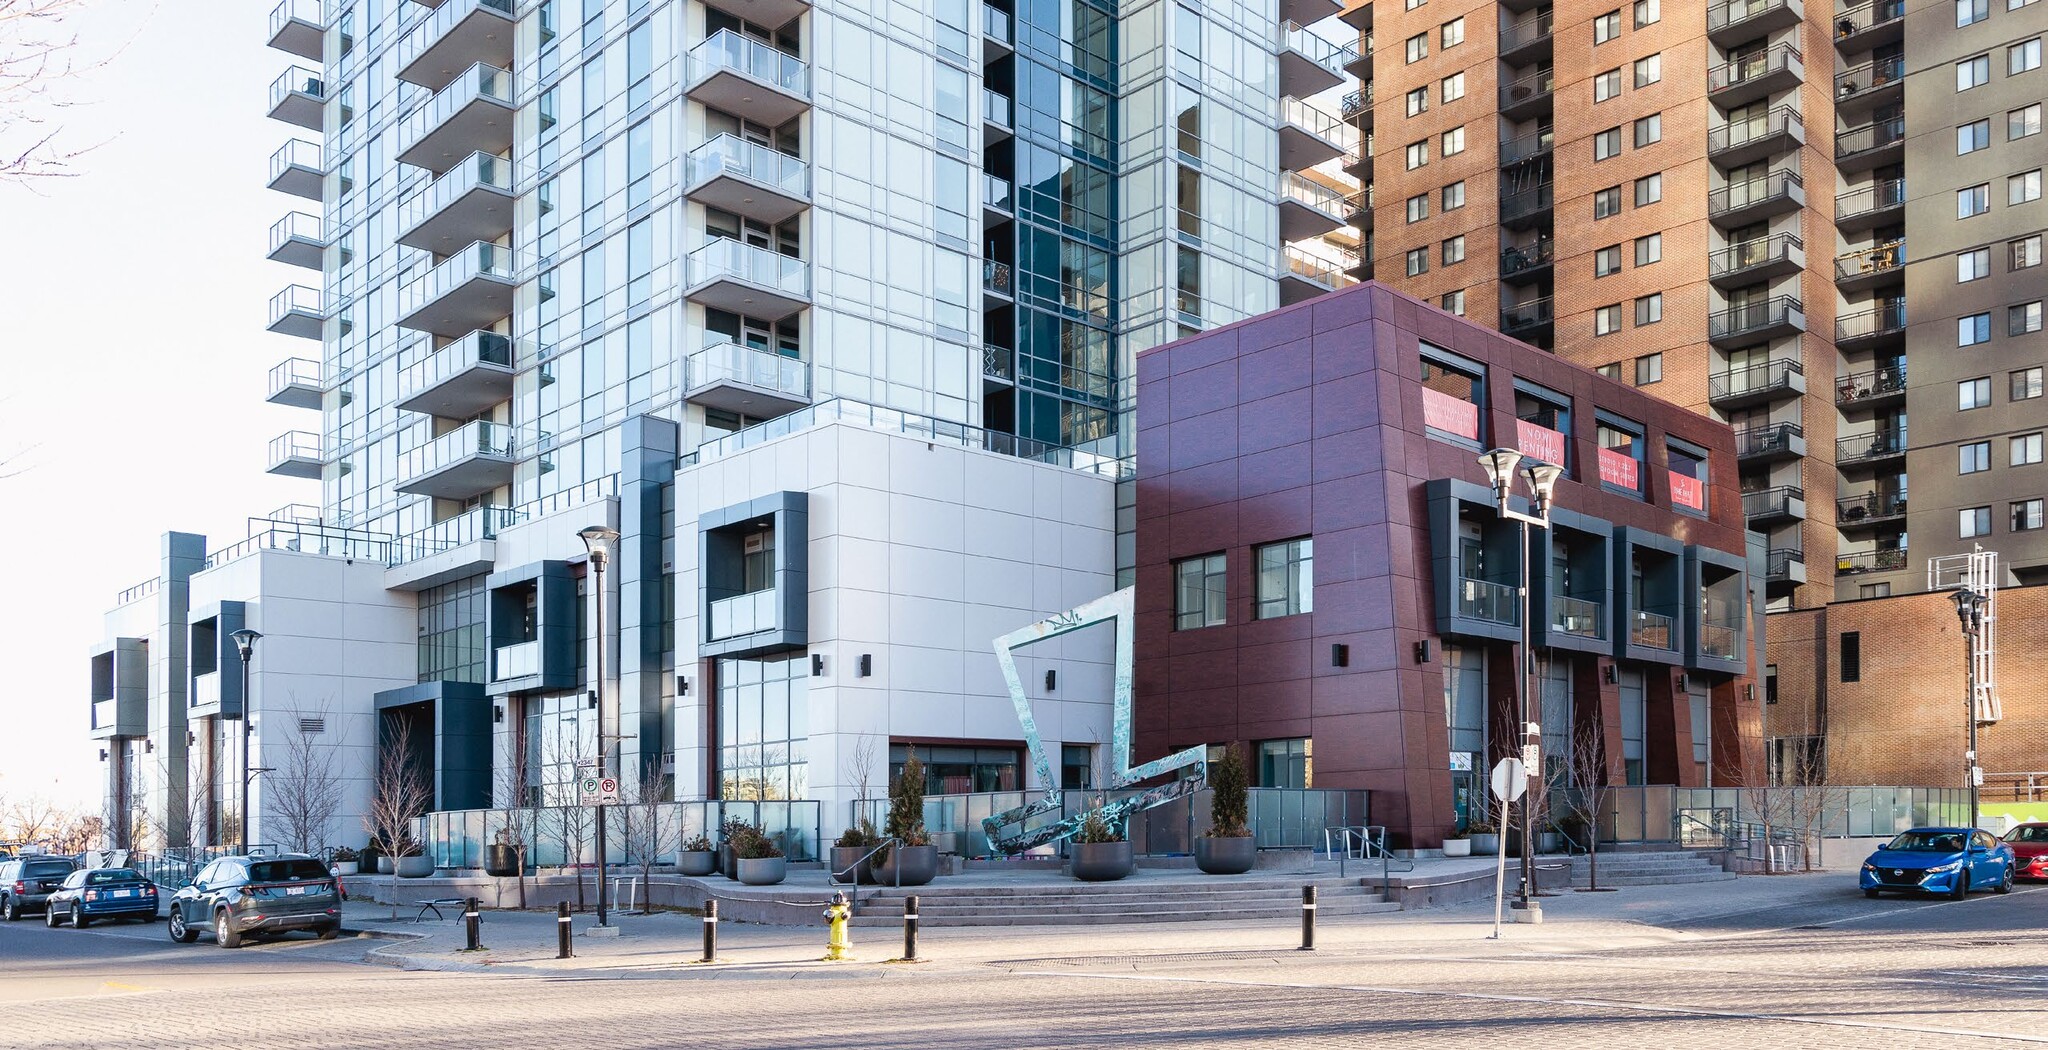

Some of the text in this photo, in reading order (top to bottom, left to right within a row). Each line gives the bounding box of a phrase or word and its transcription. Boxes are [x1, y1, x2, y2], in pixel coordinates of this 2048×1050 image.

[1526, 427, 1550, 441] NOW
[1518, 438, 1558, 460] RENTING
[588, 782, 594, 790] P
